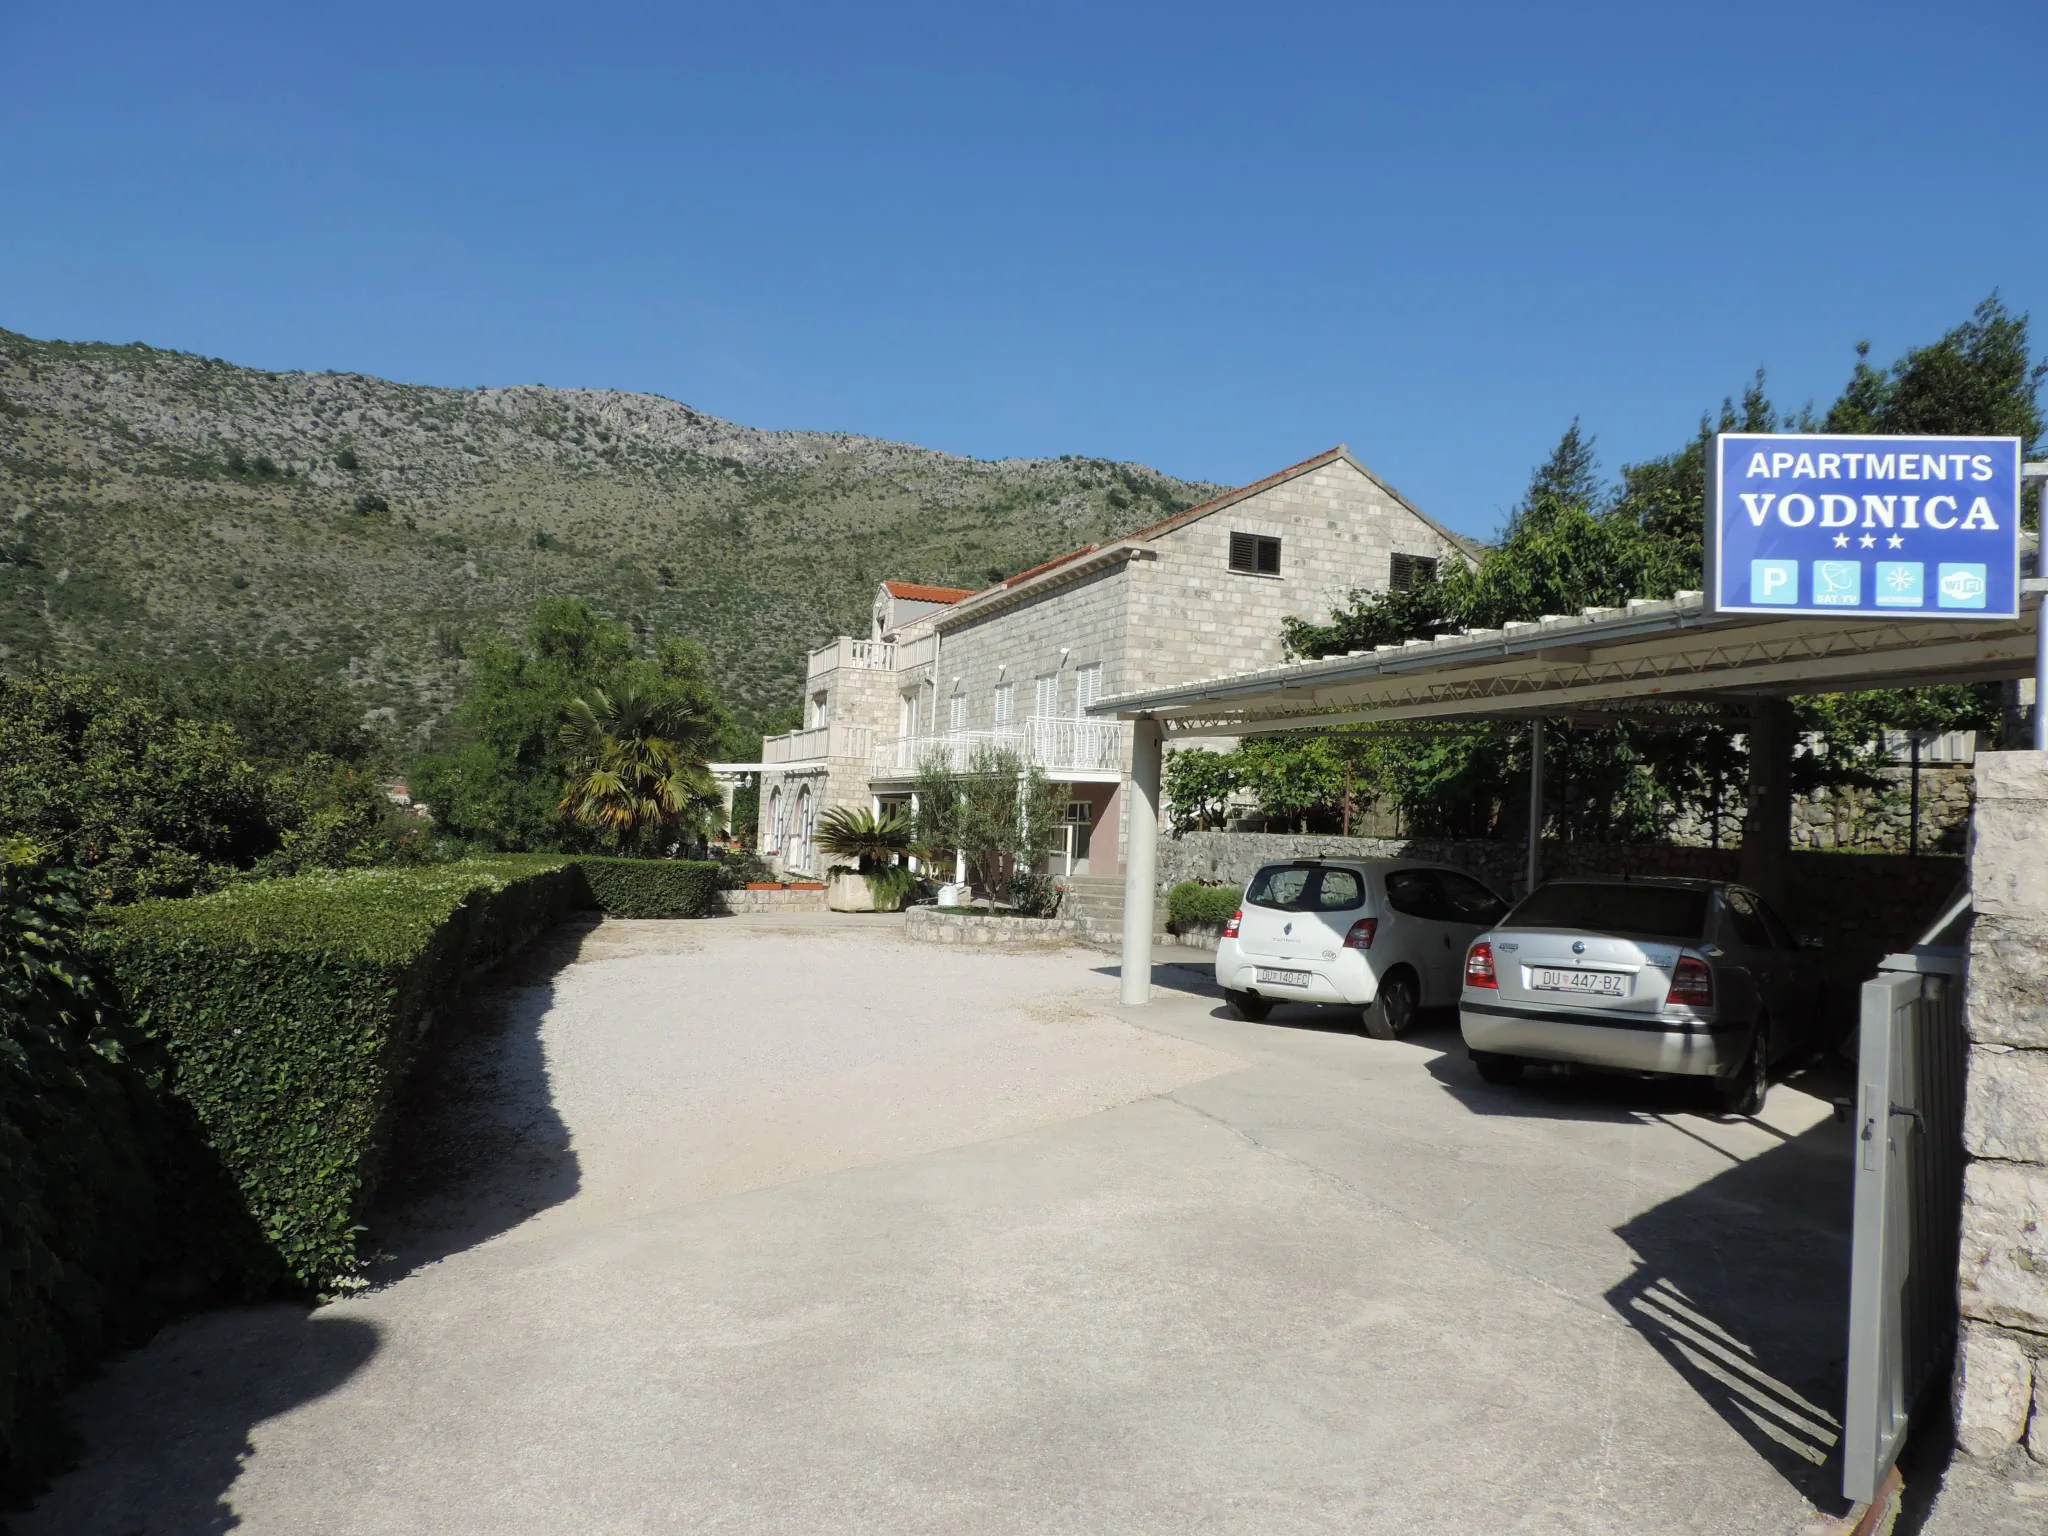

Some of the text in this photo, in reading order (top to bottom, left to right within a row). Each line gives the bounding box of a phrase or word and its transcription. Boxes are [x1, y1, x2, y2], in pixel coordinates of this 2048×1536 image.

[1746, 452, 1993, 481] APARTMENTS
[1739, 493, 2000, 530] VODNICA
[1763, 567, 1788, 596] P
[1543, 971, 1621, 990] DU 447-BZ
